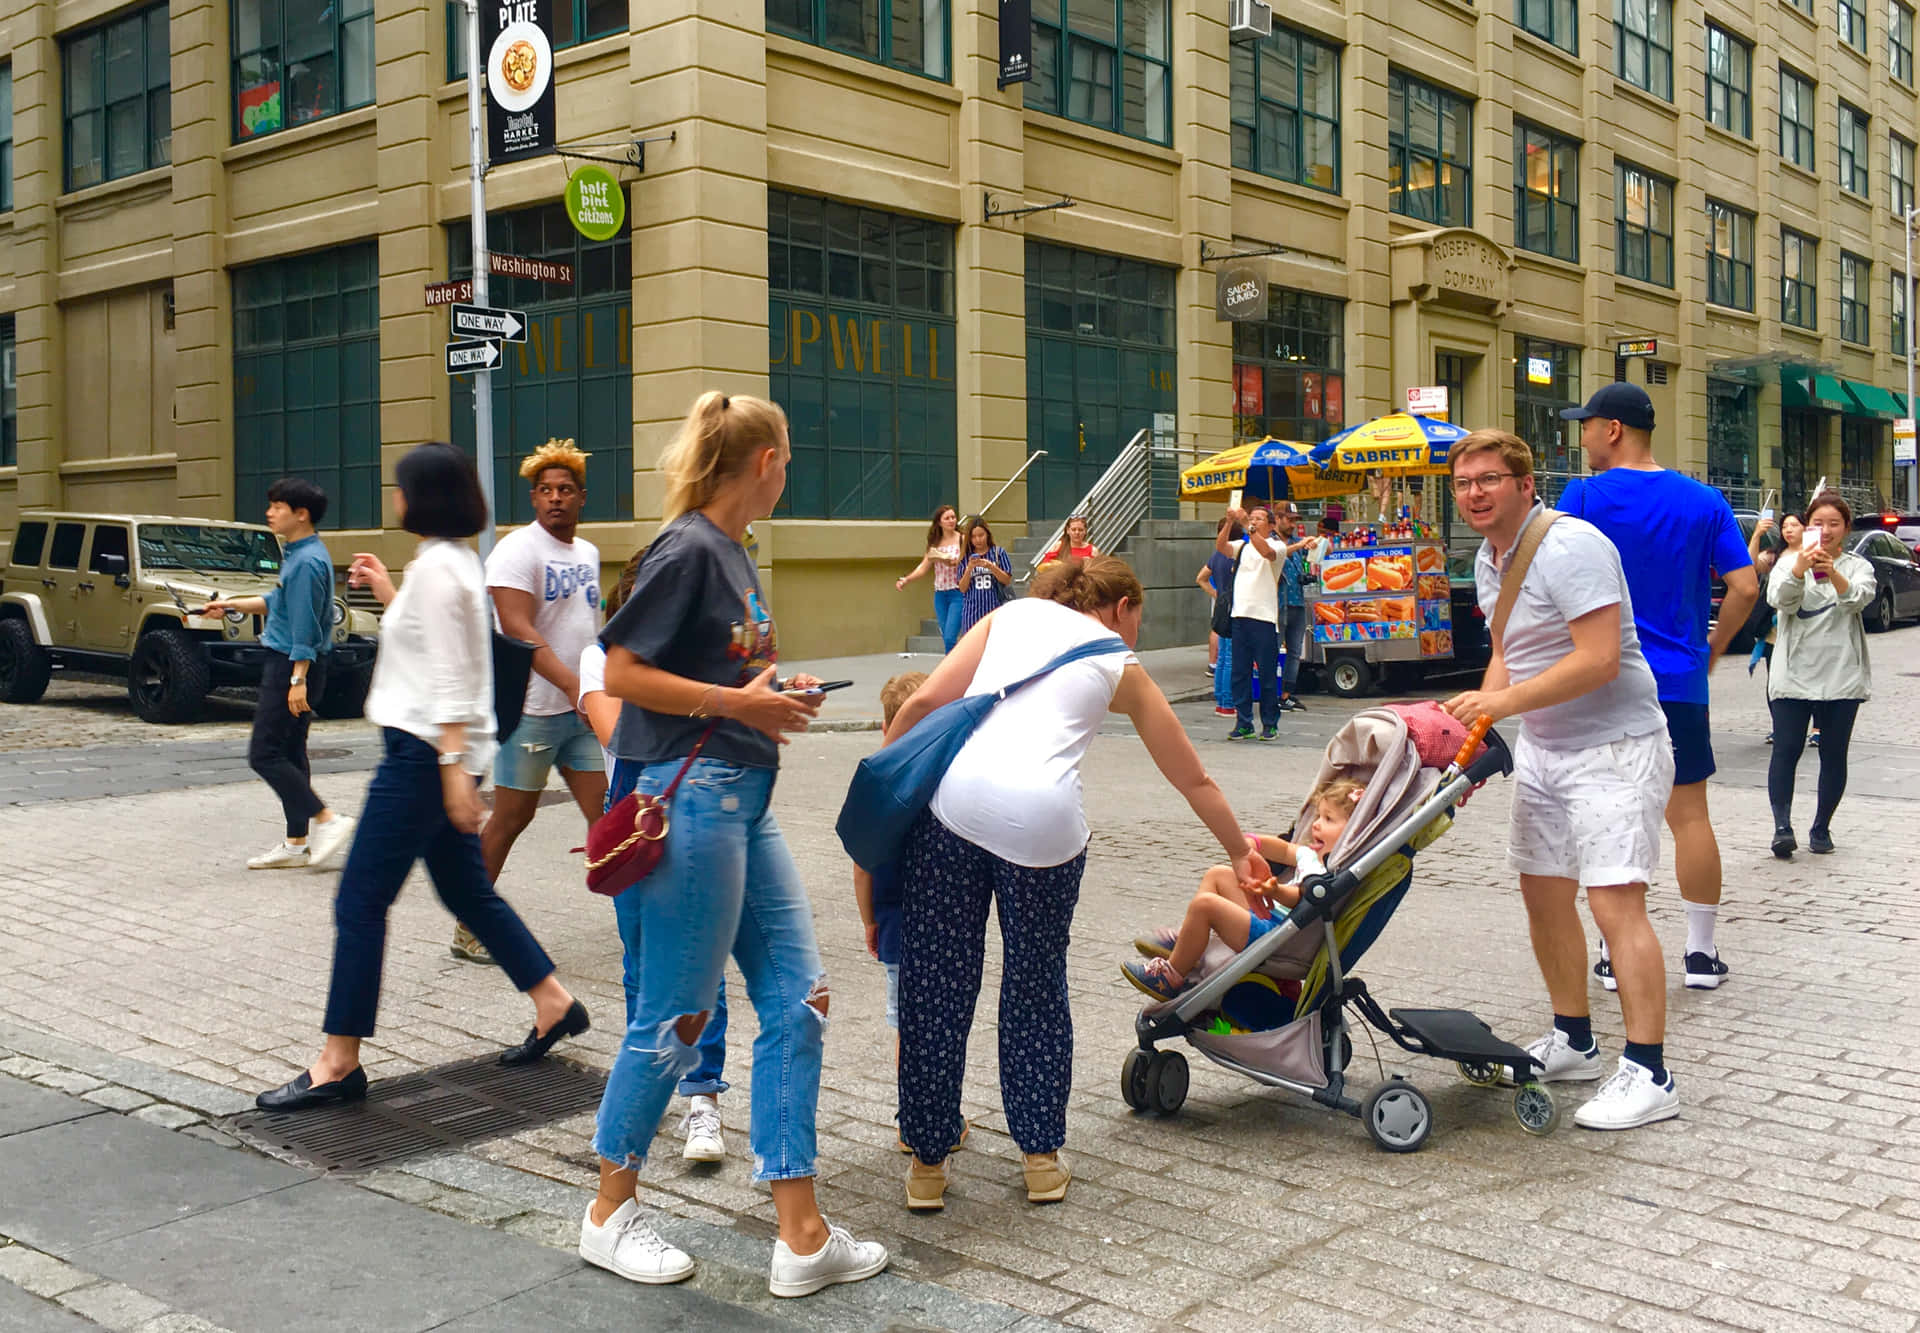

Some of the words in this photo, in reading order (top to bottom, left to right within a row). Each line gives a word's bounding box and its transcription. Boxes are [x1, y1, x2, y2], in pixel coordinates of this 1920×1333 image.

[499, 0, 537, 29] PLATE
[504, 127, 539, 140] MARKET
[580, 180, 608, 195] half
[582, 195, 609, 208] pint
[1434, 240, 1476, 261] ROBERT
[492, 256, 556, 280] Washington
[560, 266, 570, 281] St
[1227, 280, 1255, 297] SALON
[1444, 269, 1495, 292] COMPANY
[426, 285, 456, 304] Water
[461, 282, 472, 299] St
[1227, 288, 1259, 306] DUMBO
[461, 312, 481, 328] ONE
[484, 316, 505, 331] WAY
[452, 350, 468, 364] ONE
[470, 349, 486, 361] WAY
[1343, 447, 1423, 465] SABRETT
[1187, 470, 1243, 488] SABRETT
